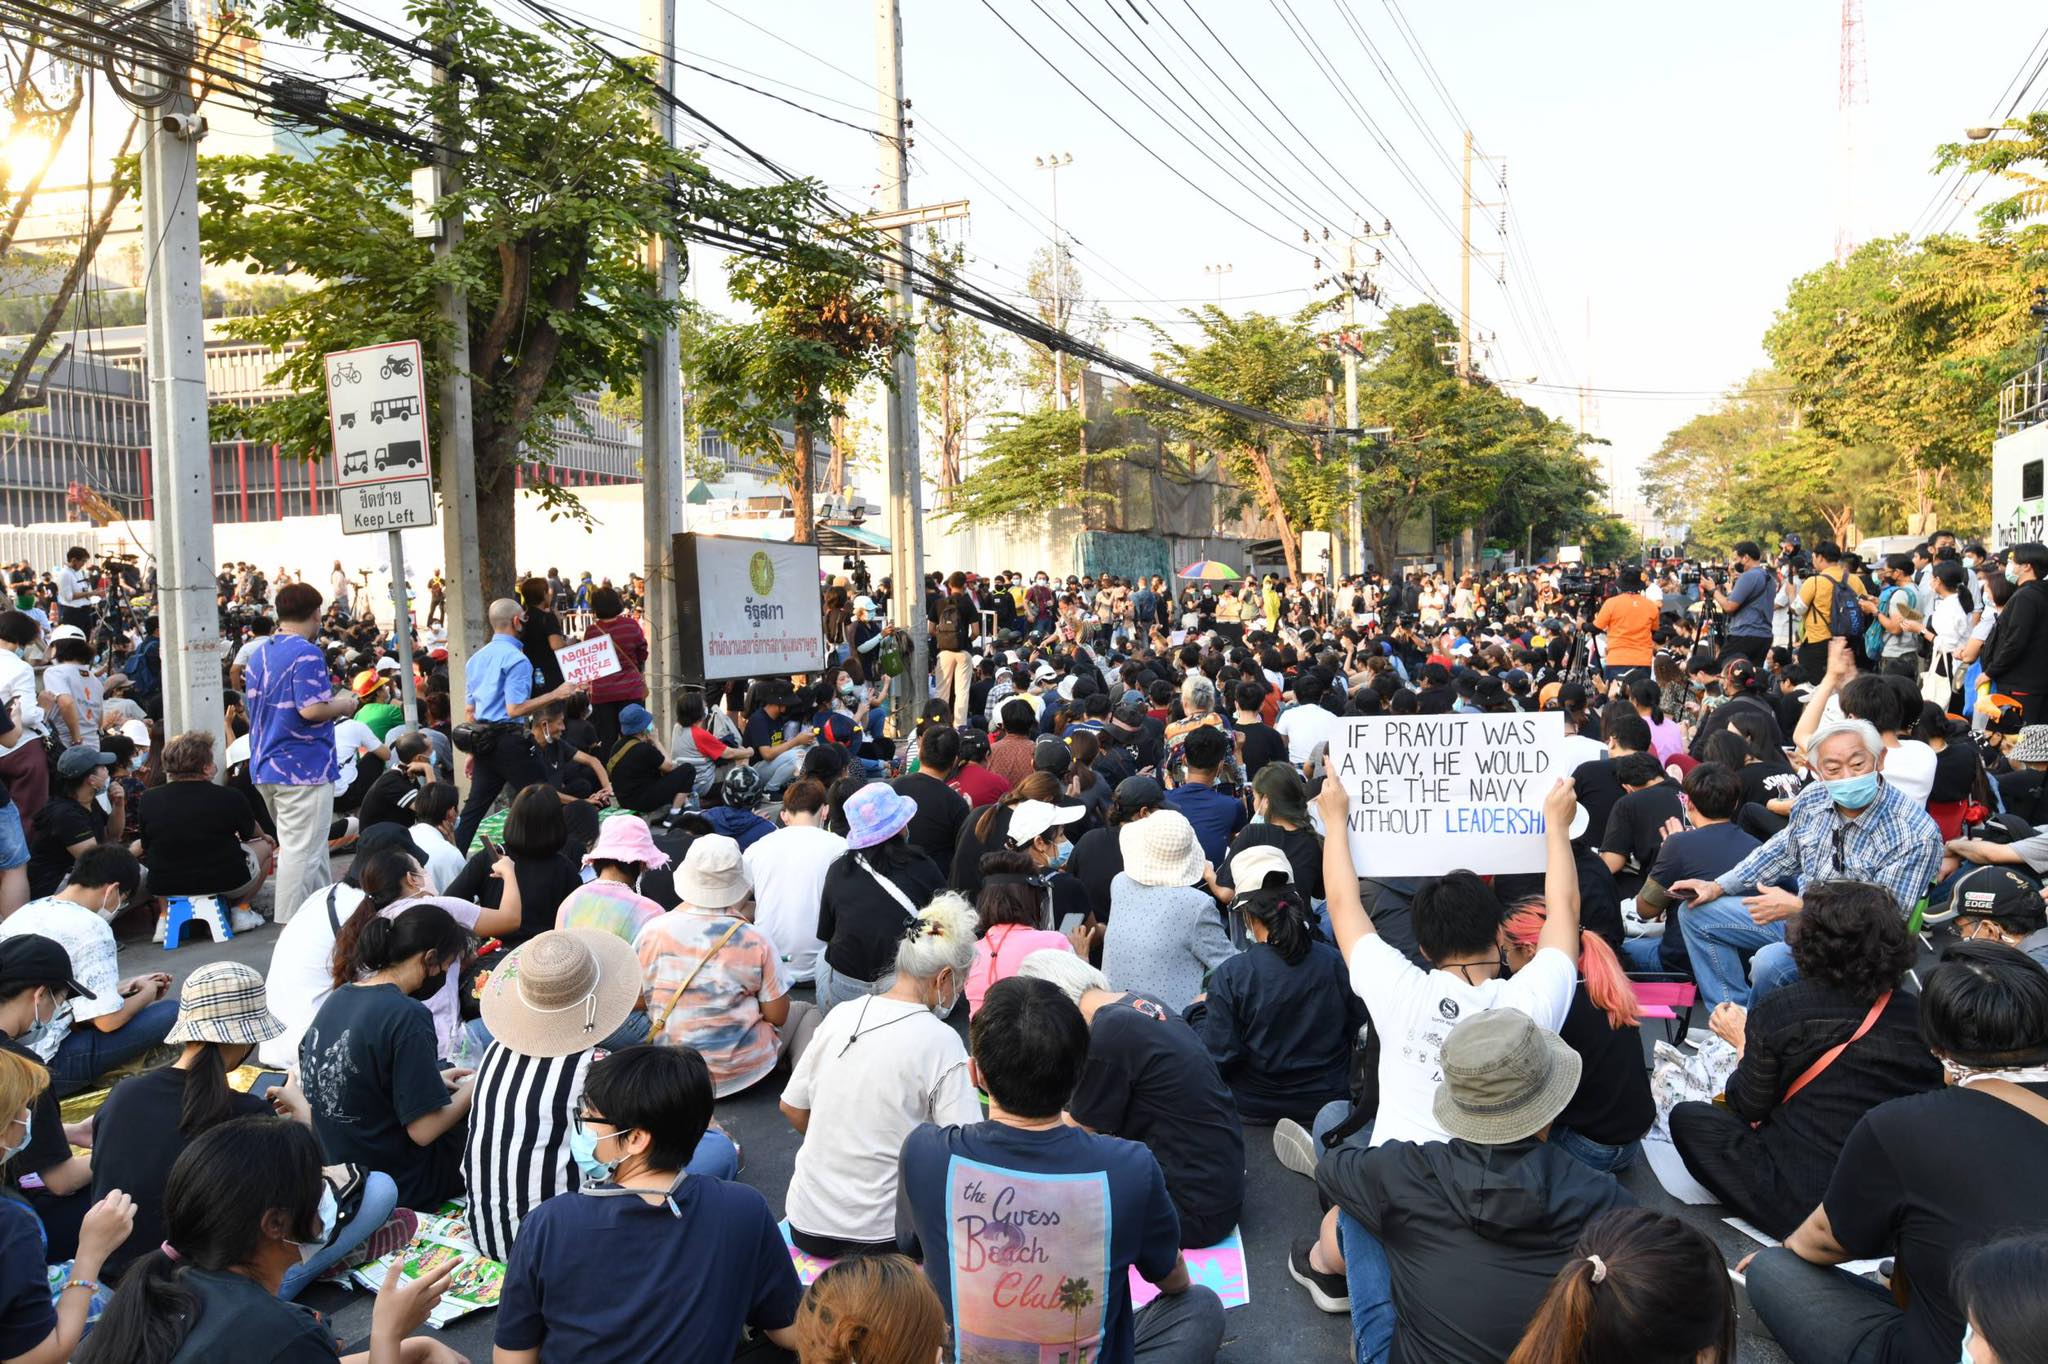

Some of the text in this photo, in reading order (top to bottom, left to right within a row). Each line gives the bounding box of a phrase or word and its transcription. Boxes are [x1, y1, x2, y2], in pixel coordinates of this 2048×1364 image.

[354, 508, 415, 529] Keep Left
[2030, 514, 2044, 545] 32
[744, 596, 784, 628] รัฐสภา
[561, 640, 608, 664] ABOLISH
[577, 653, 598, 667] THE
[568, 658, 612, 680] ARTICLE
[1348, 720, 1536, 749] IF PRAYUT WAS
[1340, 750, 1549, 779] A NAVY, HE WOULD
[1361, 778, 1528, 804] BE THE NAVY
[1445, 807, 1546, 835] LEADERSHI
[1964, 900, 1994, 909] EDGE
[963, 1180, 988, 1204] the
[957, 1215, 1049, 1273] Beach
[992, 1271, 1069, 1311] Club
